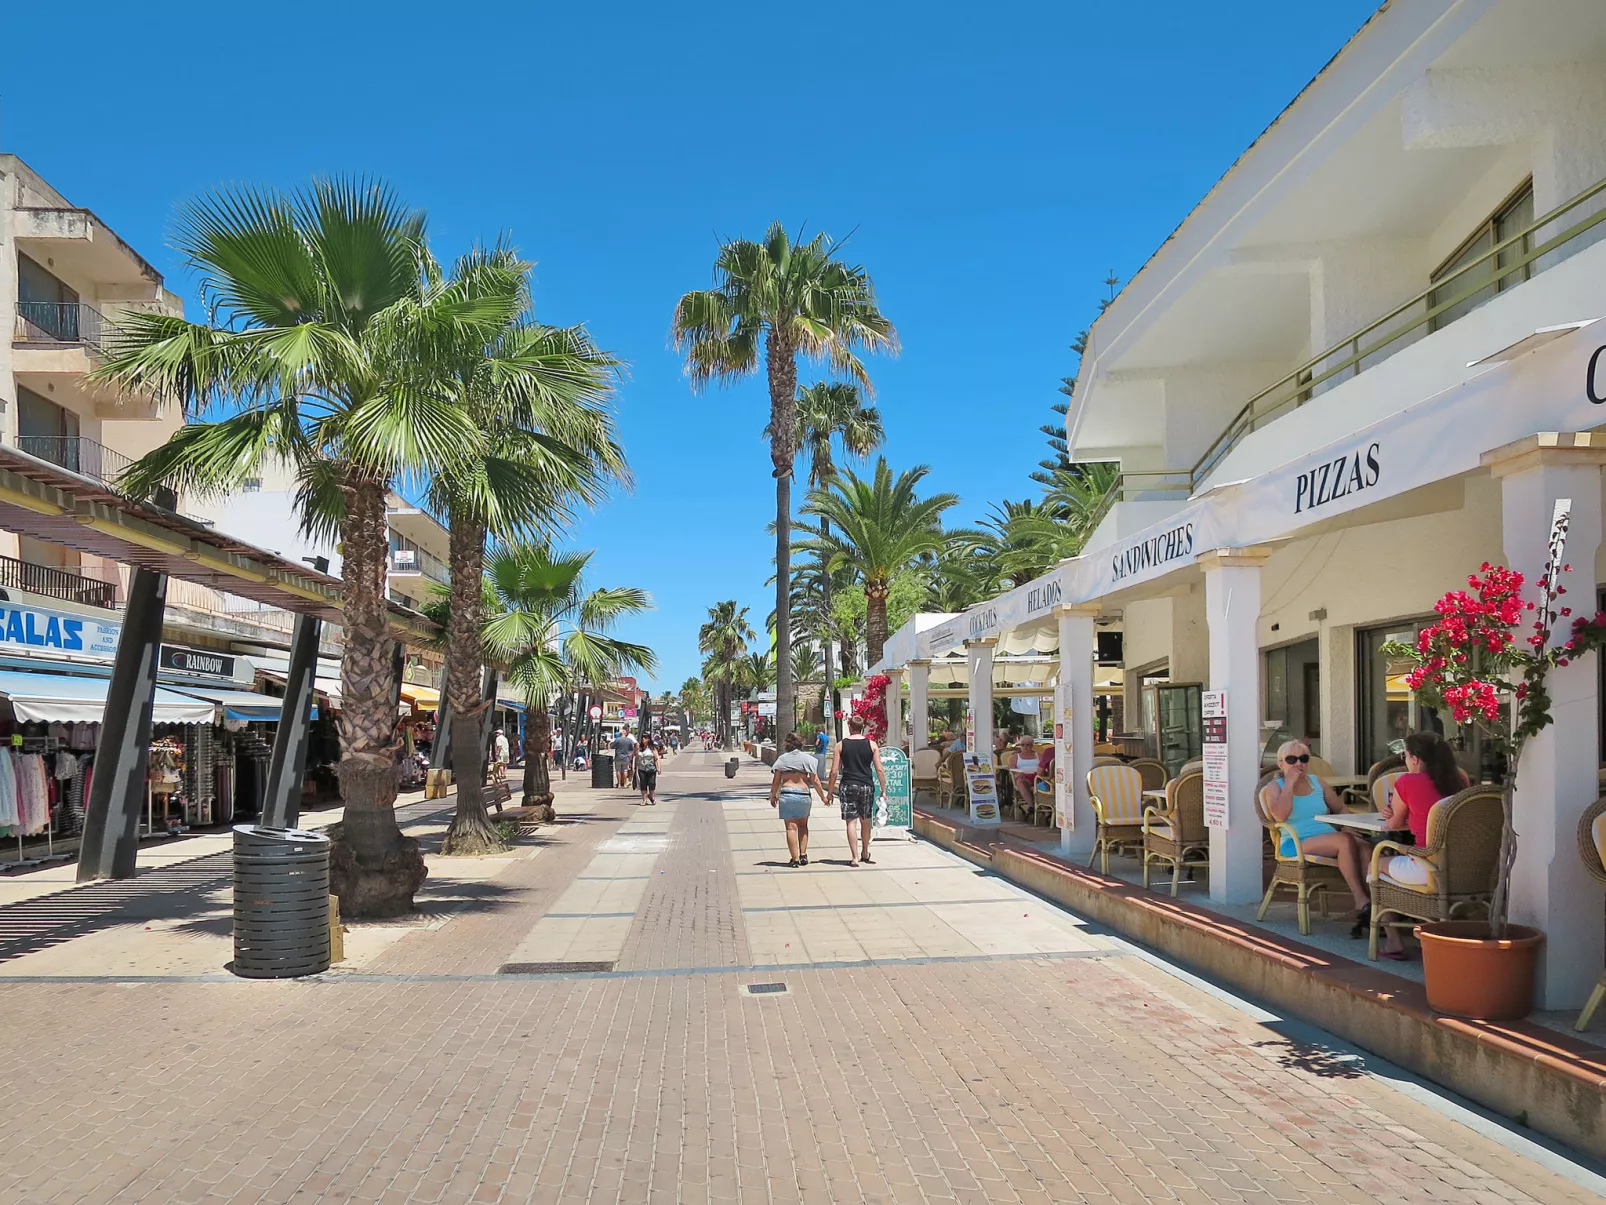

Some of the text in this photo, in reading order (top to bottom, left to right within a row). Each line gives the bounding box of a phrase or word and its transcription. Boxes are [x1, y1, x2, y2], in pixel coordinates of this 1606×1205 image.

[1294, 441, 1379, 514] PIZZAS
[1112, 523, 1193, 582] SANDWICHES
[1027, 579, 1062, 613] HELADOS
[969, 608, 998, 635] COCKTAILS
[186, 654, 222, 673] RAINBOW
